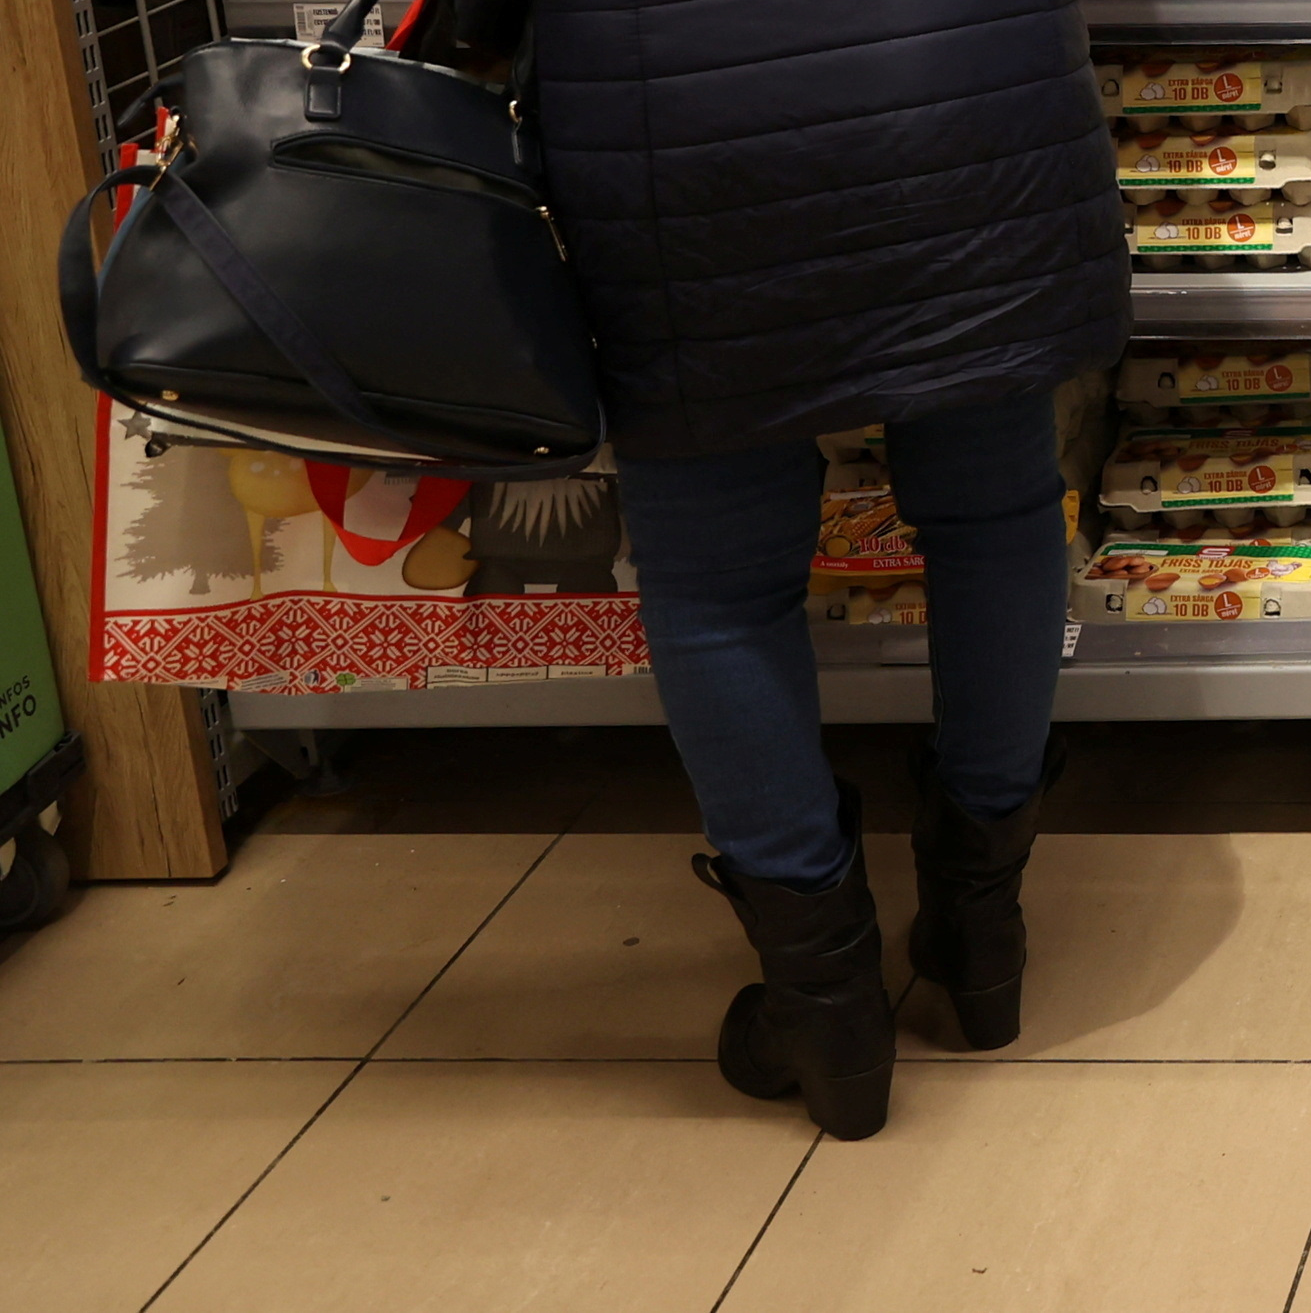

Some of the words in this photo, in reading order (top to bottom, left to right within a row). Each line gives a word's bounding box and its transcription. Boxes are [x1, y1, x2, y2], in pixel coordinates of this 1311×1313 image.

[859, 537, 881, 554] 10
[885, 536, 907, 553] db
[874, 558, 901, 568] EXTRA
[1162, 559, 1203, 568] FRISS
